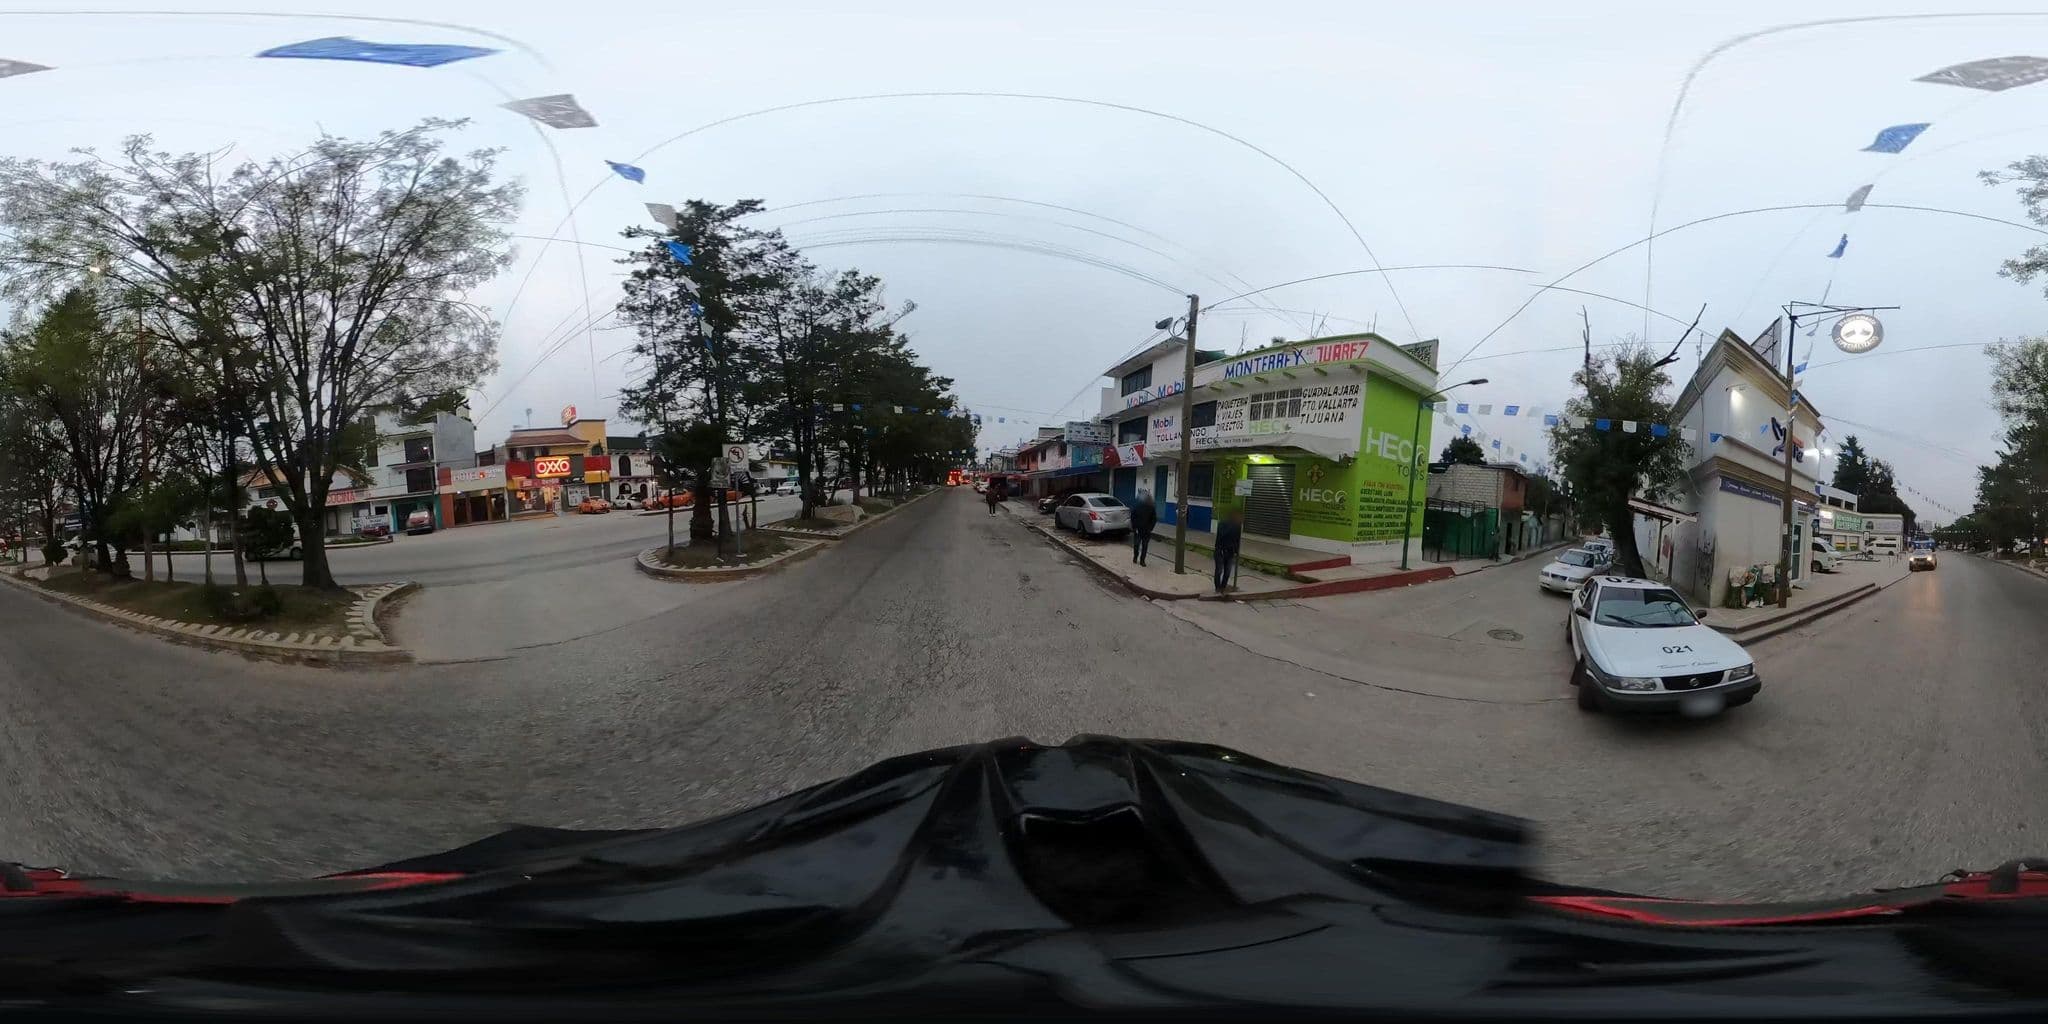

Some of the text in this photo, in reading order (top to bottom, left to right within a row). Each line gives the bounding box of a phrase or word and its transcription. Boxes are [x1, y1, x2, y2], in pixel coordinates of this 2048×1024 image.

[1158, 379, 1185, 398] Mobi
[1303, 385, 1360, 399] GUADALAJARA
[1318, 398, 1359, 410] VALLARTA
[1153, 416, 1174, 429] Mobil
[1301, 412, 1345, 425] TIJUANA
[1216, 421, 1244, 432] DIRECTOS
[537, 461, 569, 475] OXXO
[1397, 464, 1425, 481] TORS
[1662, 645, 1693, 655] 021
